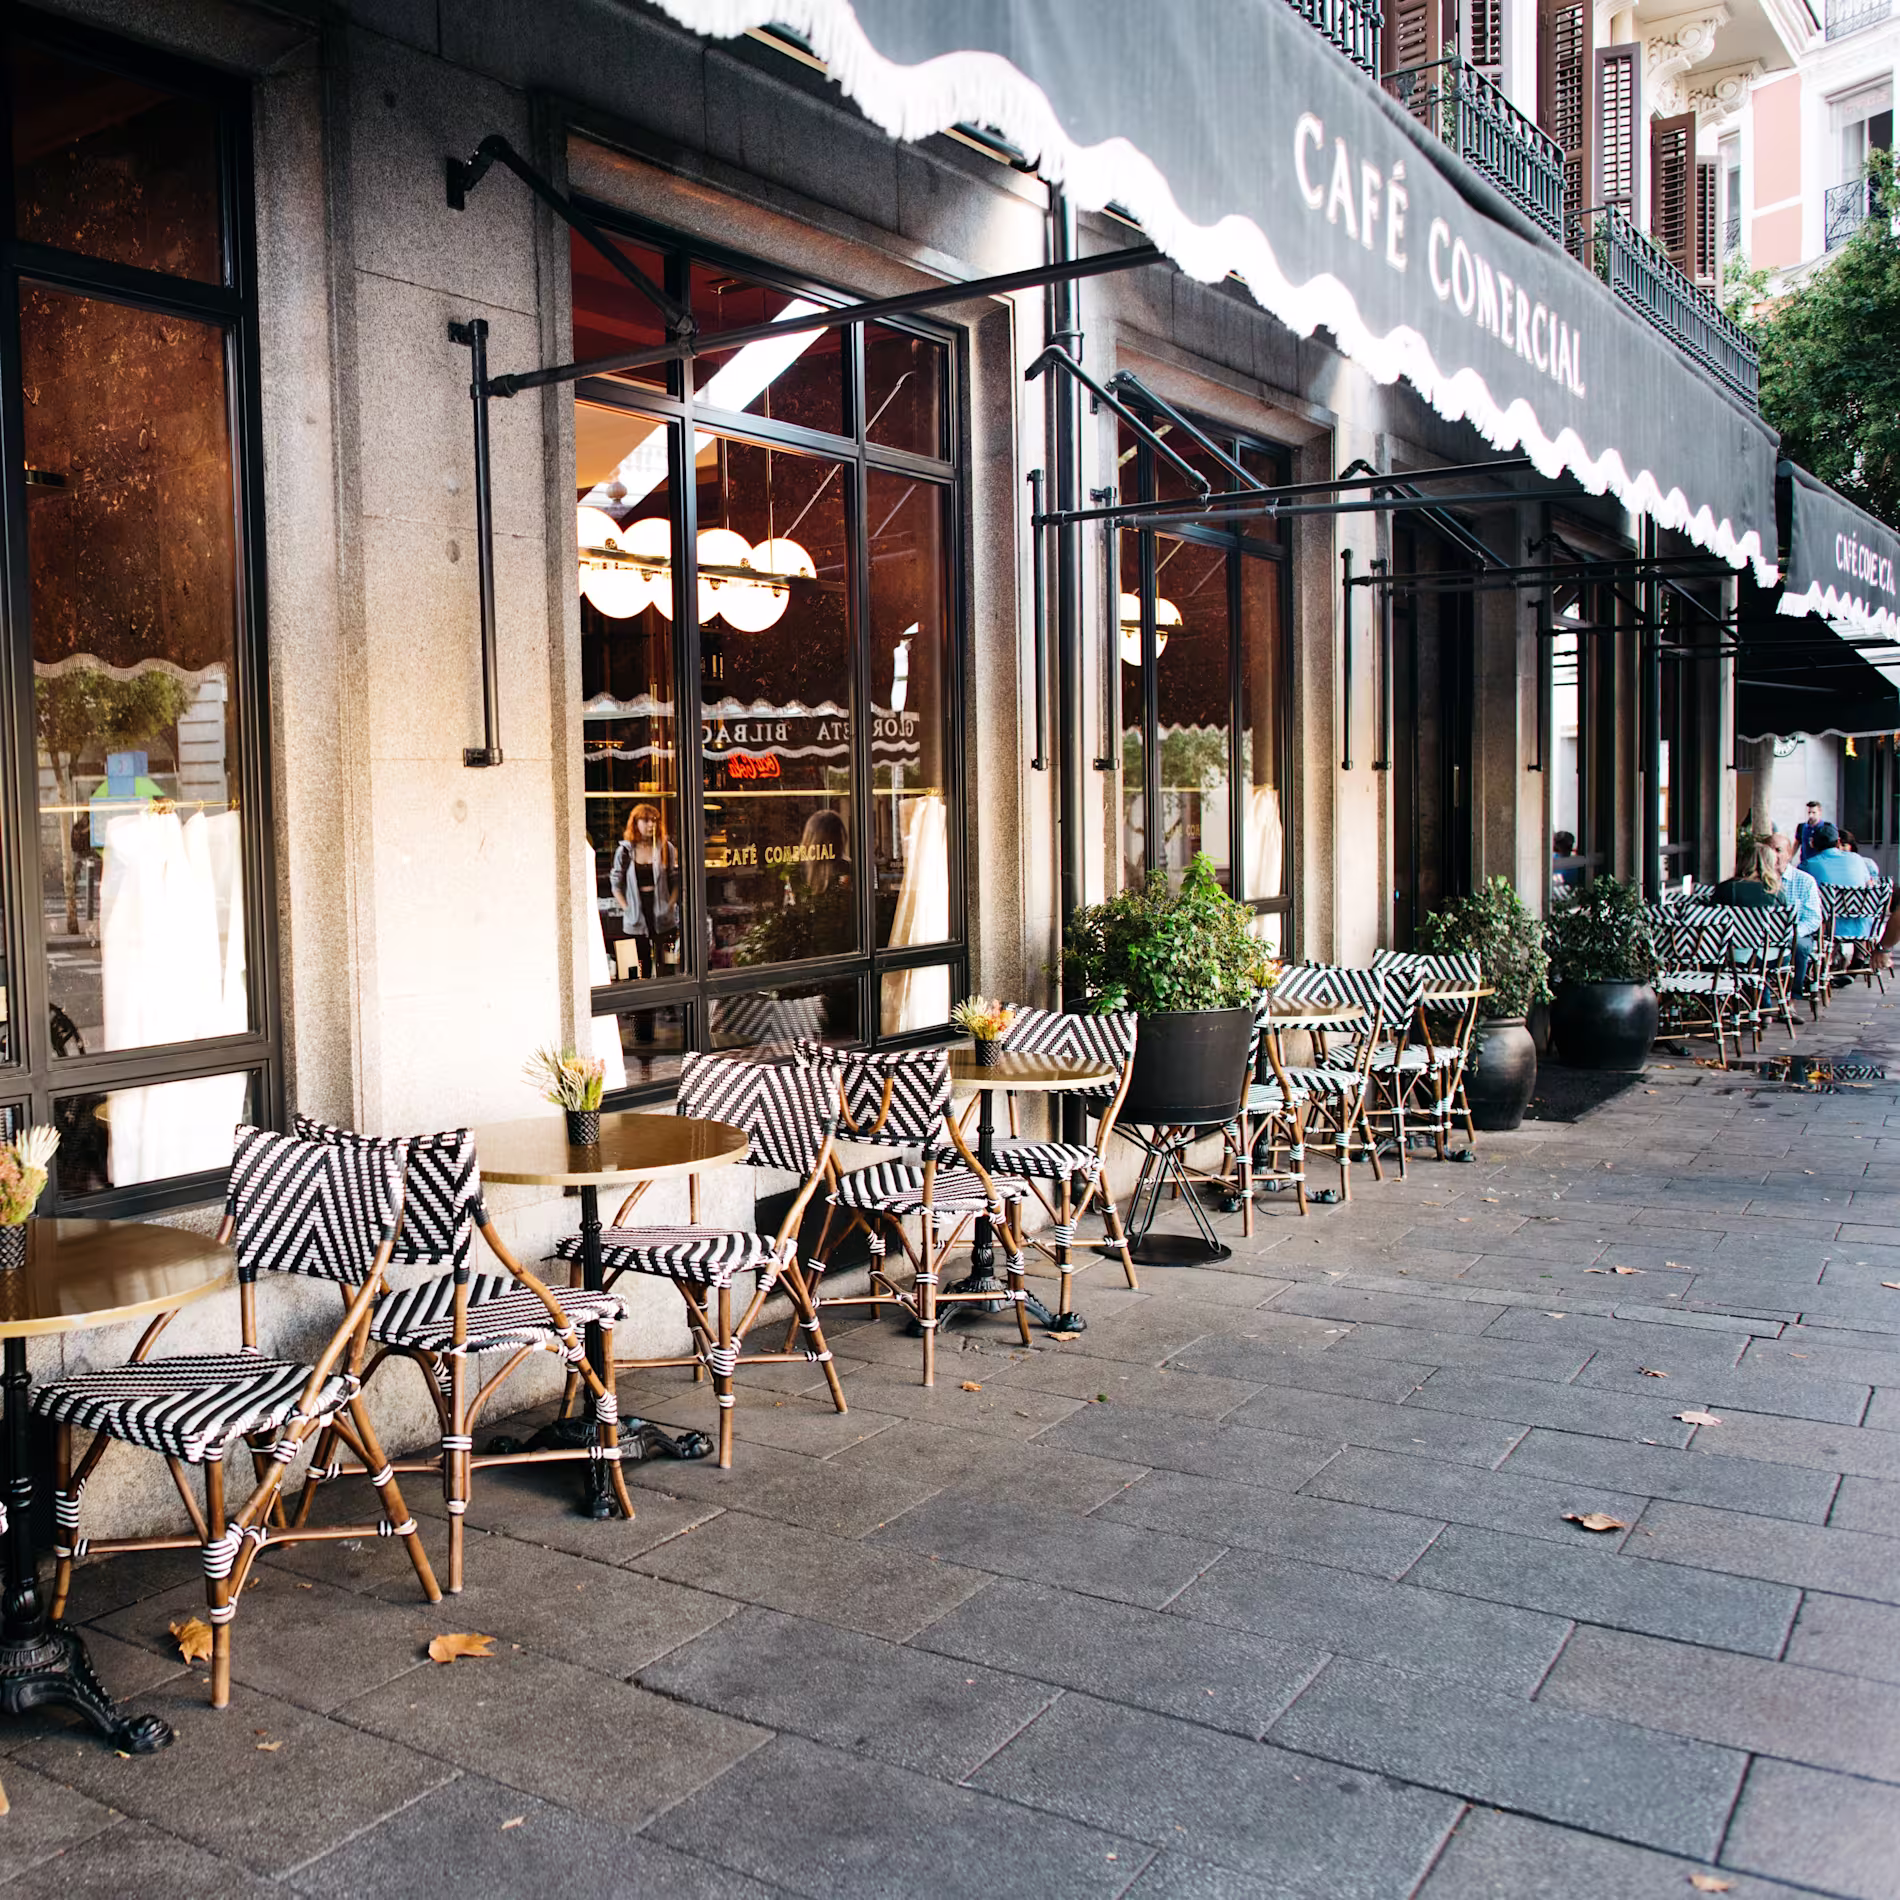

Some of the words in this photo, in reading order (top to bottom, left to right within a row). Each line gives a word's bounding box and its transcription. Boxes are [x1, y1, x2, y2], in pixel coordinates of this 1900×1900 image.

[1293, 111, 1410, 273] CAFÉ
[1427, 216, 1586, 399] COMERCIAL
[723, 843, 758, 867] CAFÉ
[764, 843, 836, 863] COMERCIAL
